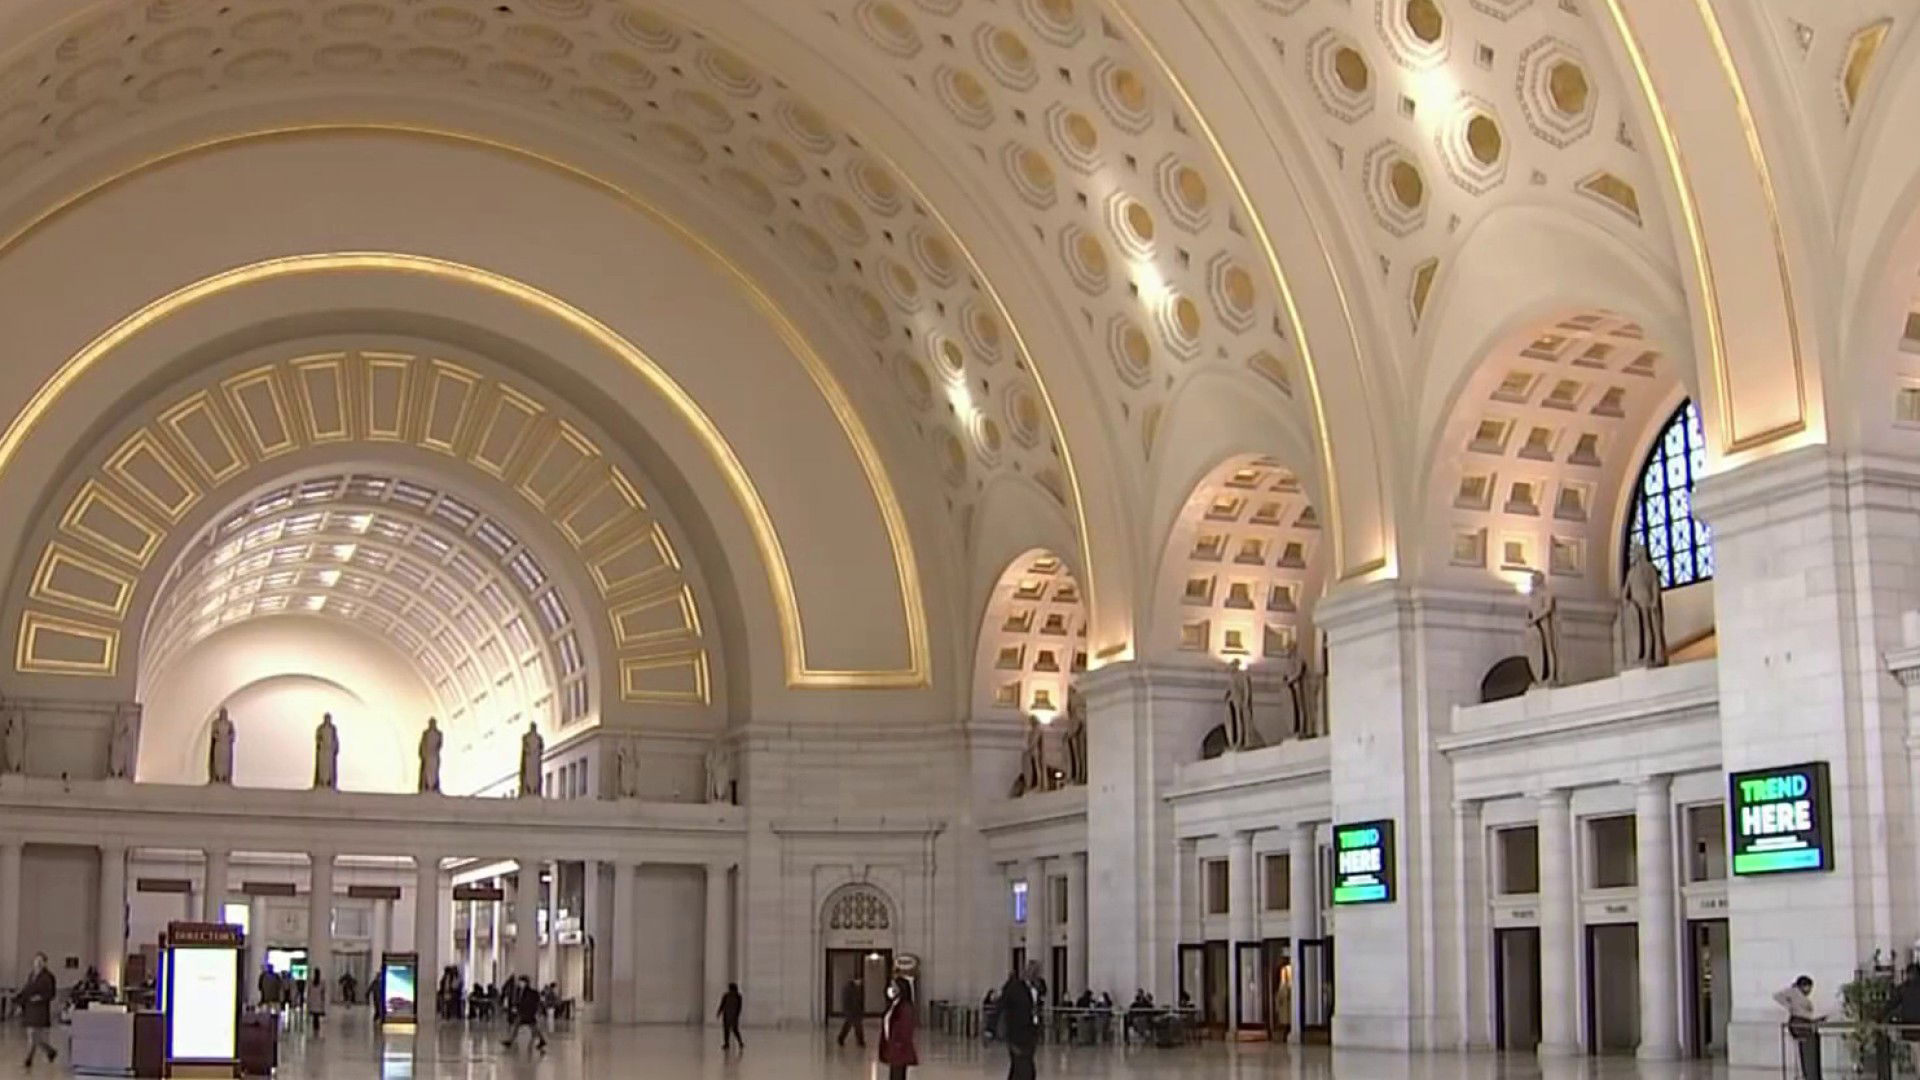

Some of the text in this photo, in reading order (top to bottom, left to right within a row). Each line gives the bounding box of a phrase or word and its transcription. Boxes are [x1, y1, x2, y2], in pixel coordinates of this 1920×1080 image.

[1740, 774, 1808, 802] TREND
[1741, 800, 1812, 836] HERE
[1339, 847, 1381, 874] HERE
